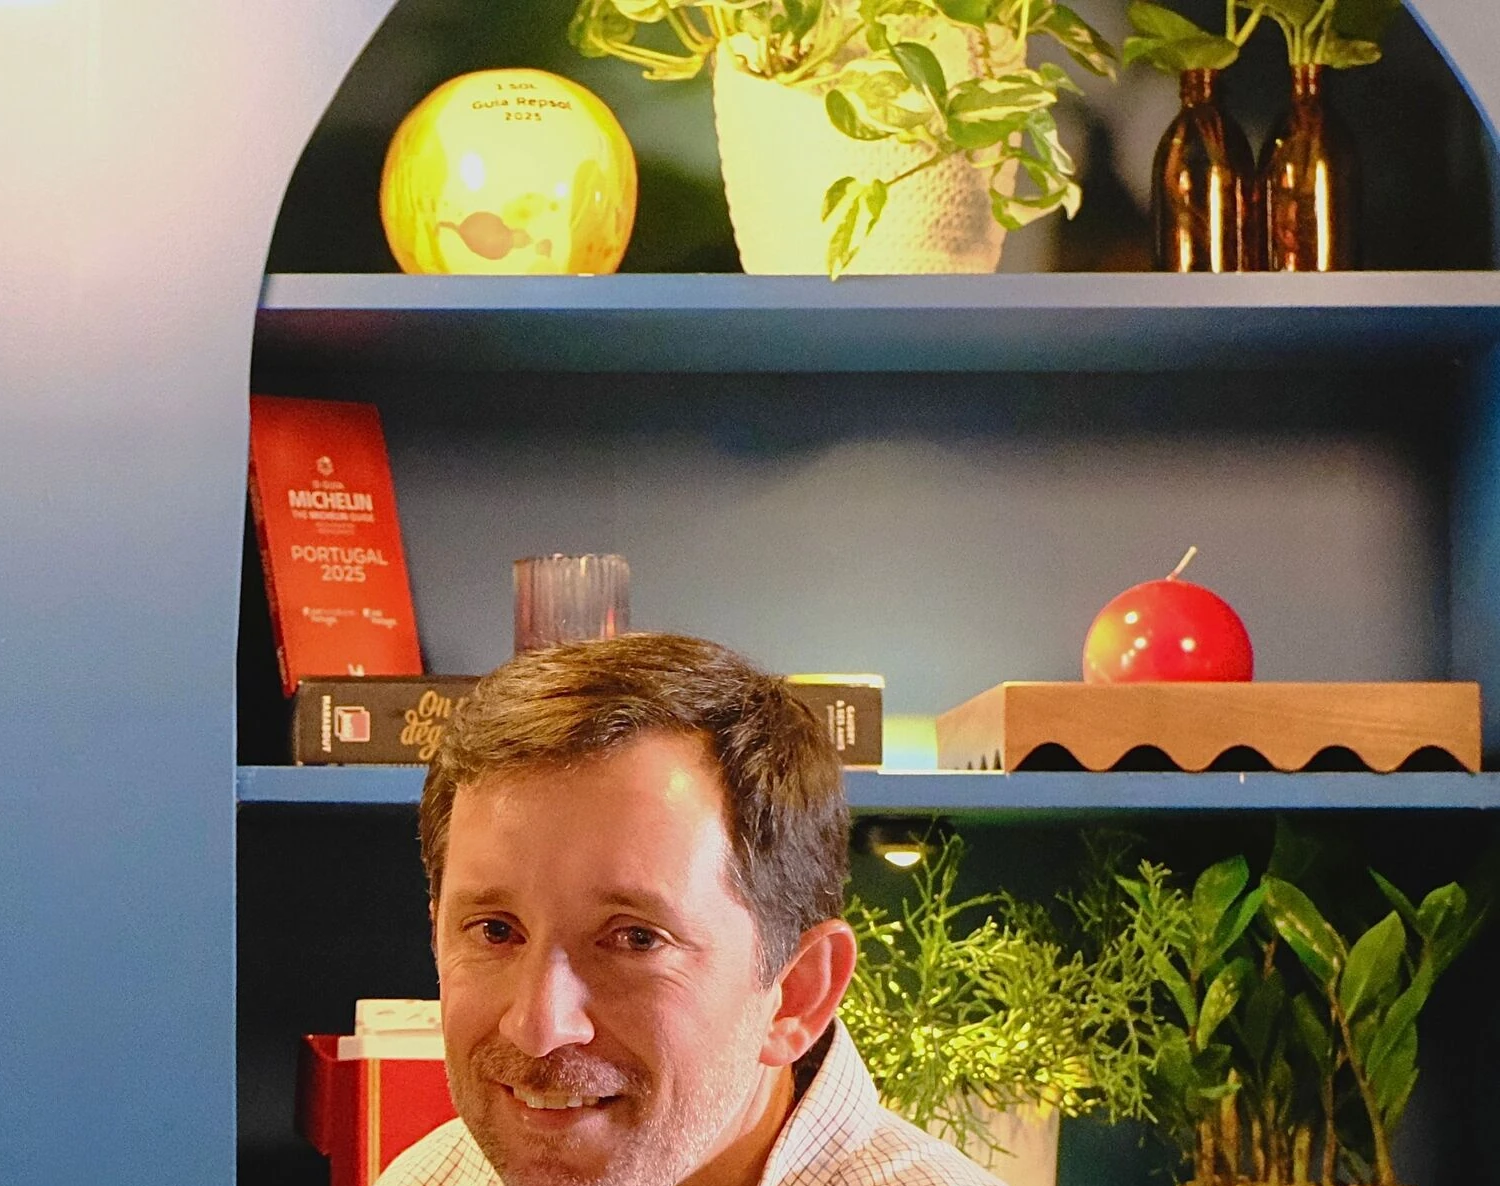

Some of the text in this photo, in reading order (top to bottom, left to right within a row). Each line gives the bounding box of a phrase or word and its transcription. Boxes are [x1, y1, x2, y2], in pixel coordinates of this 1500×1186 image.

[516, 97, 572, 111] Repsol
[505, 112, 542, 121] 2025
[287, 489, 374, 512] MICHELIN
[290, 545, 389, 567] PORTUGAL
[320, 564, 367, 582] 2025
